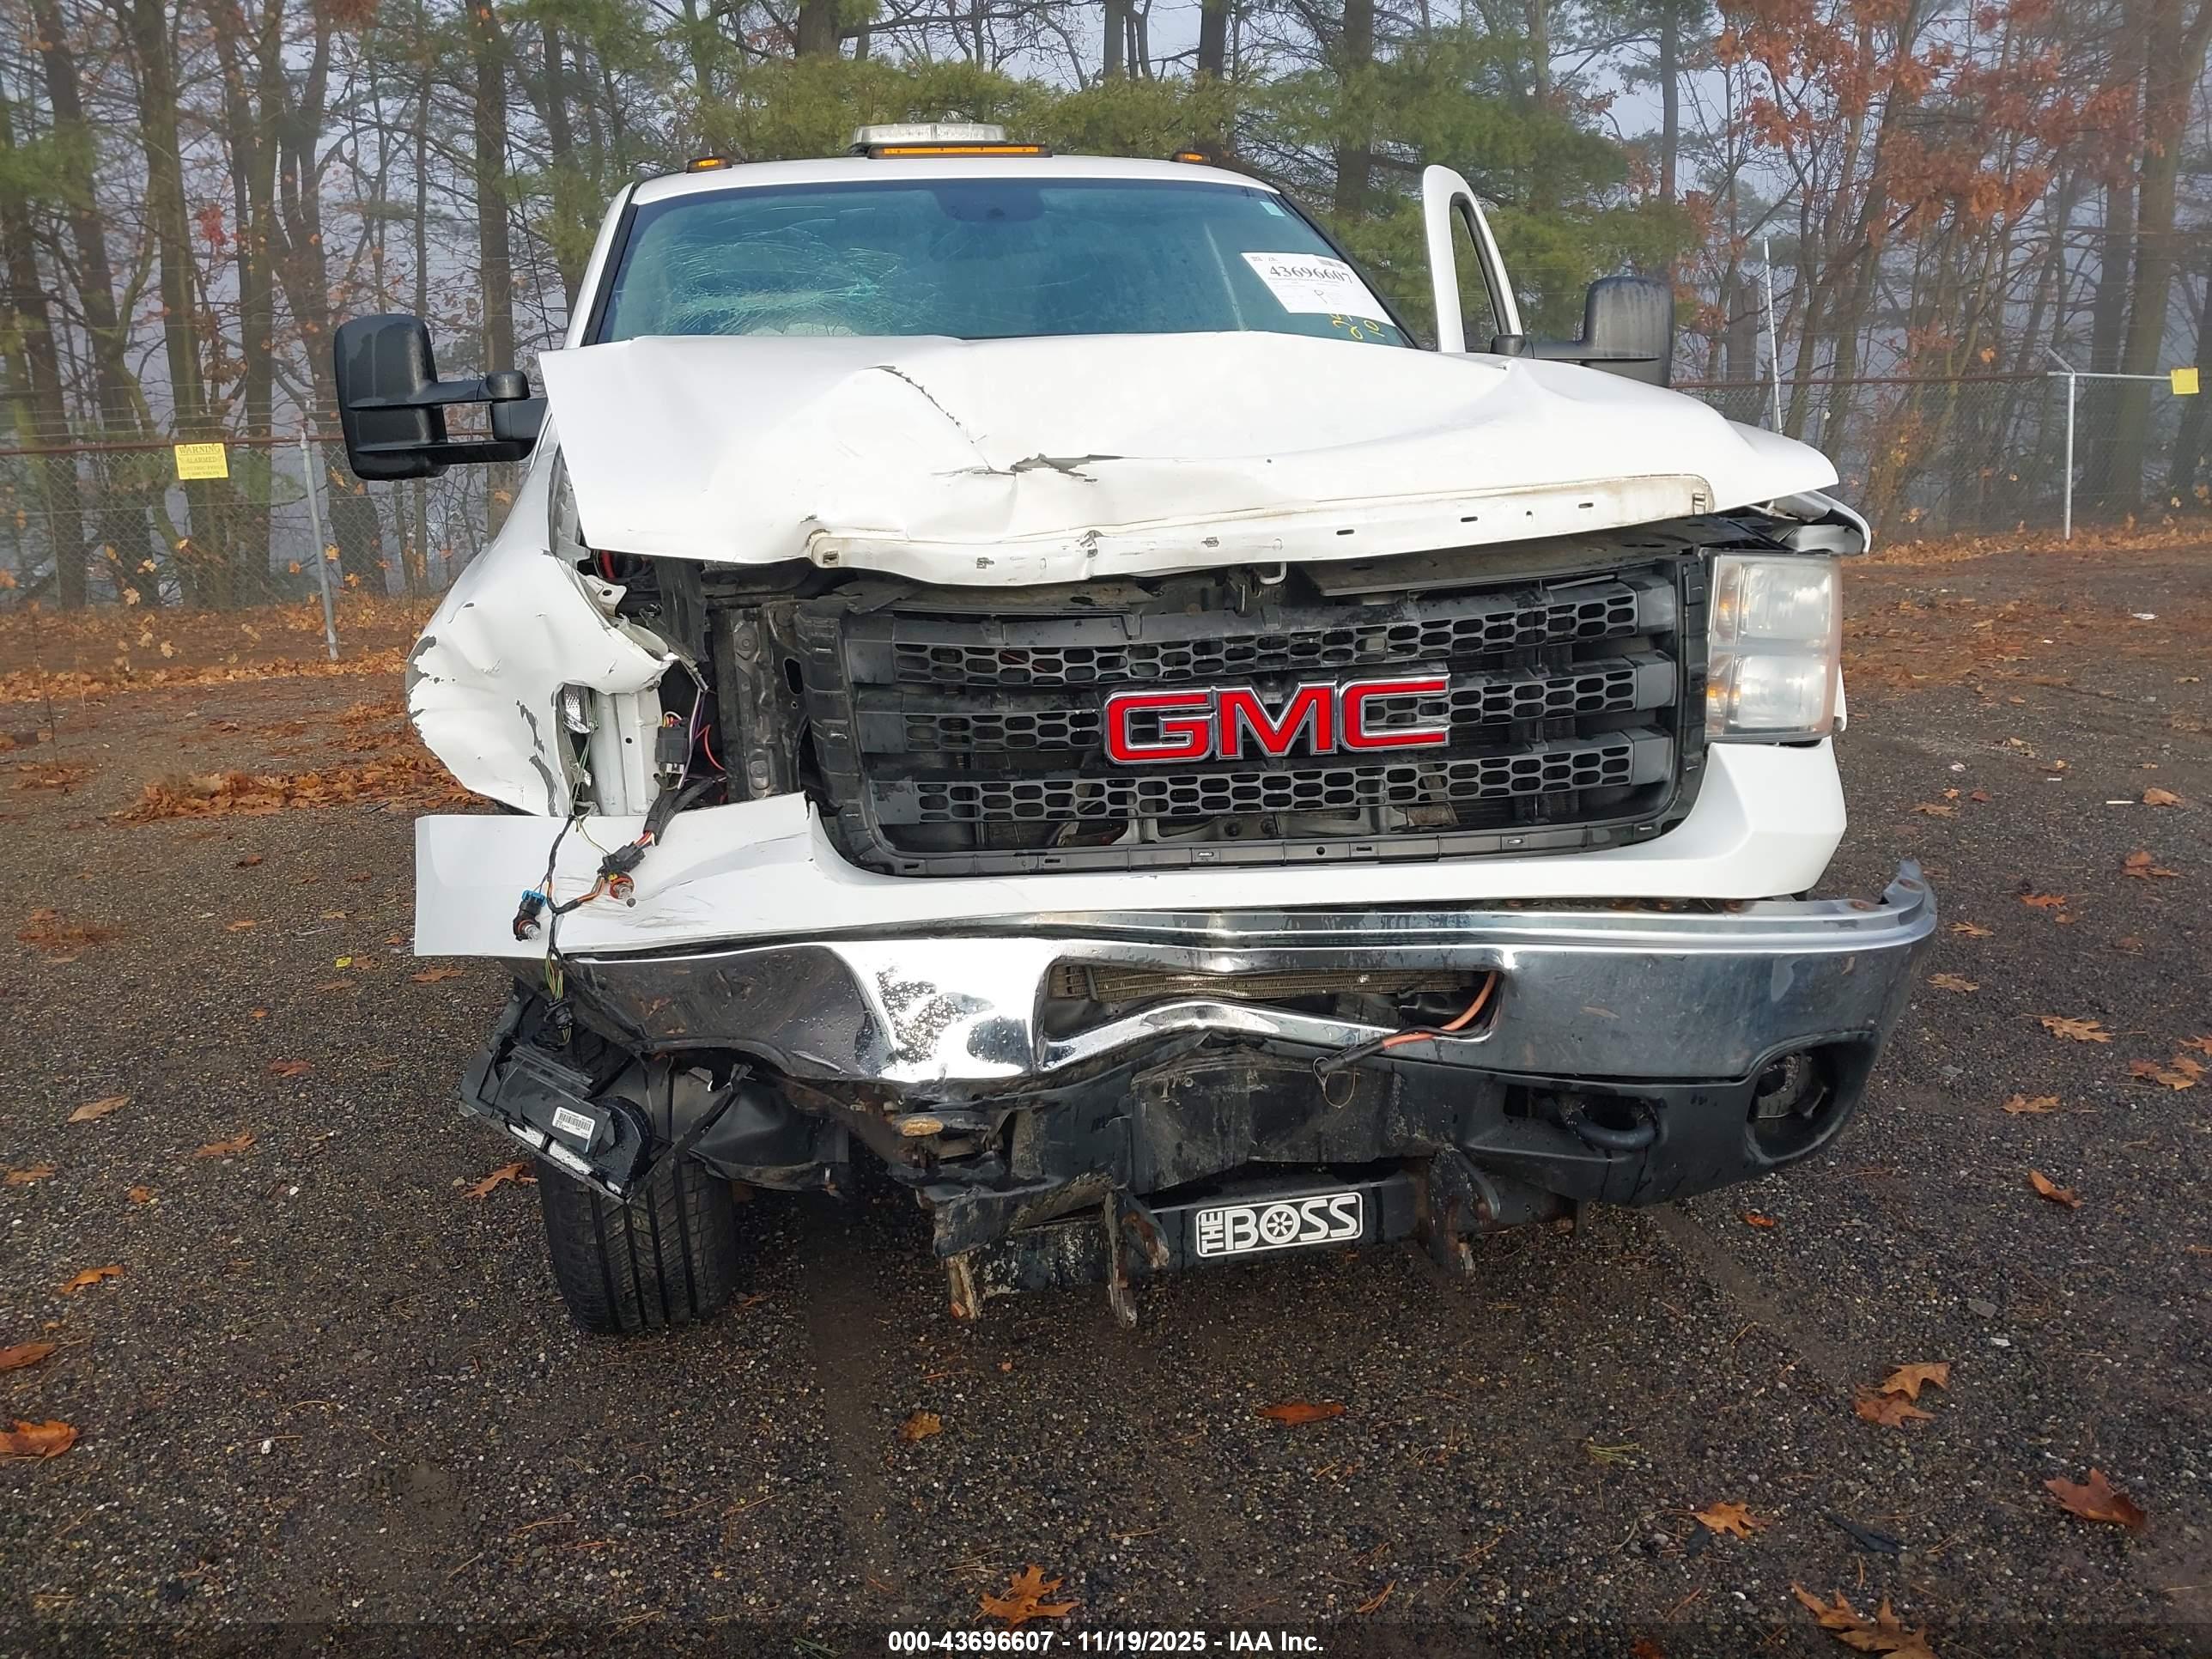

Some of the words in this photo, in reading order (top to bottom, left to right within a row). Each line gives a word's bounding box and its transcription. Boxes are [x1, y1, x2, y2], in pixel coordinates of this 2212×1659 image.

[1269, 265, 1353, 284] 43696607
[178, 446, 221, 454] WARNING
[1105, 673, 1451, 764] GMC
[1201, 1211, 1224, 1254] THE
[1224, 1195, 1357, 1251] BOSS
